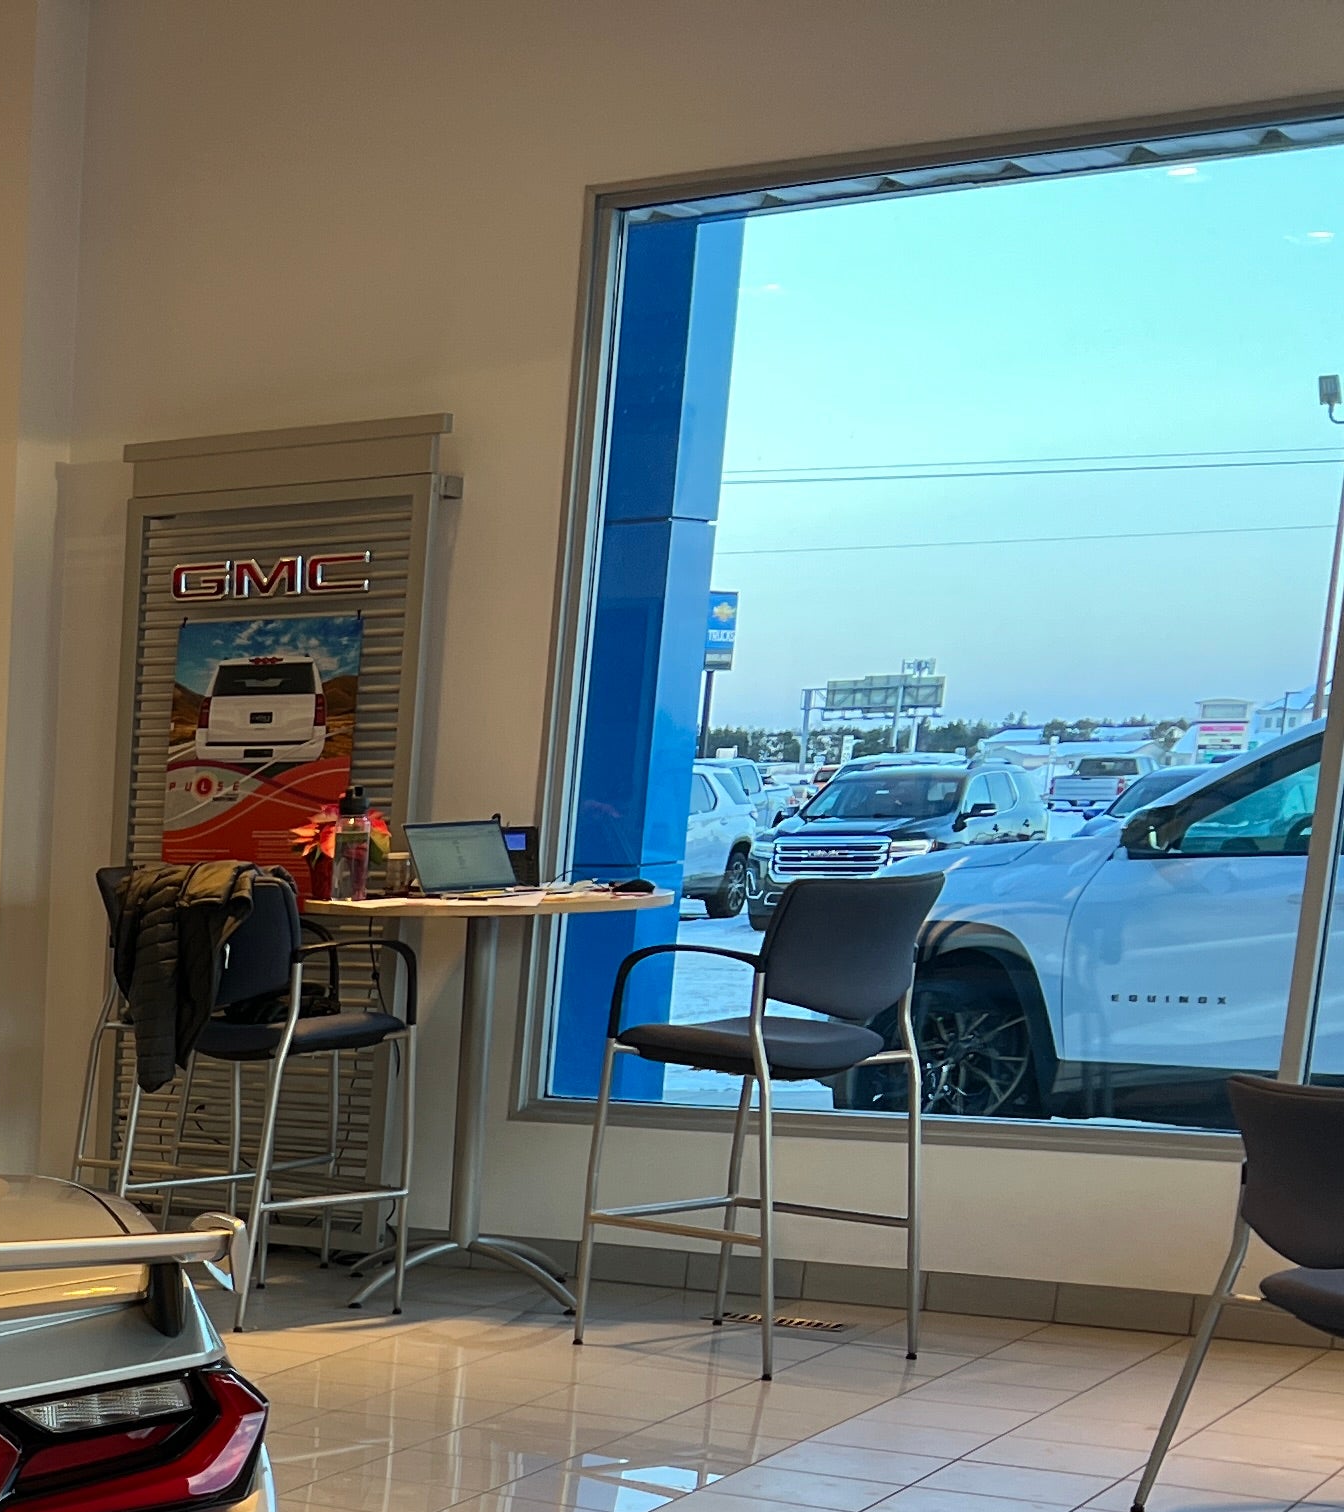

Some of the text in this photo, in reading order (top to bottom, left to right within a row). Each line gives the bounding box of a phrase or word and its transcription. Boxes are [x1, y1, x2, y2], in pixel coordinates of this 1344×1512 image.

[171, 550, 372, 600] GMC
[169, 781, 240, 791] PULSE
[1111, 994, 1226, 1005] EQUINOX
